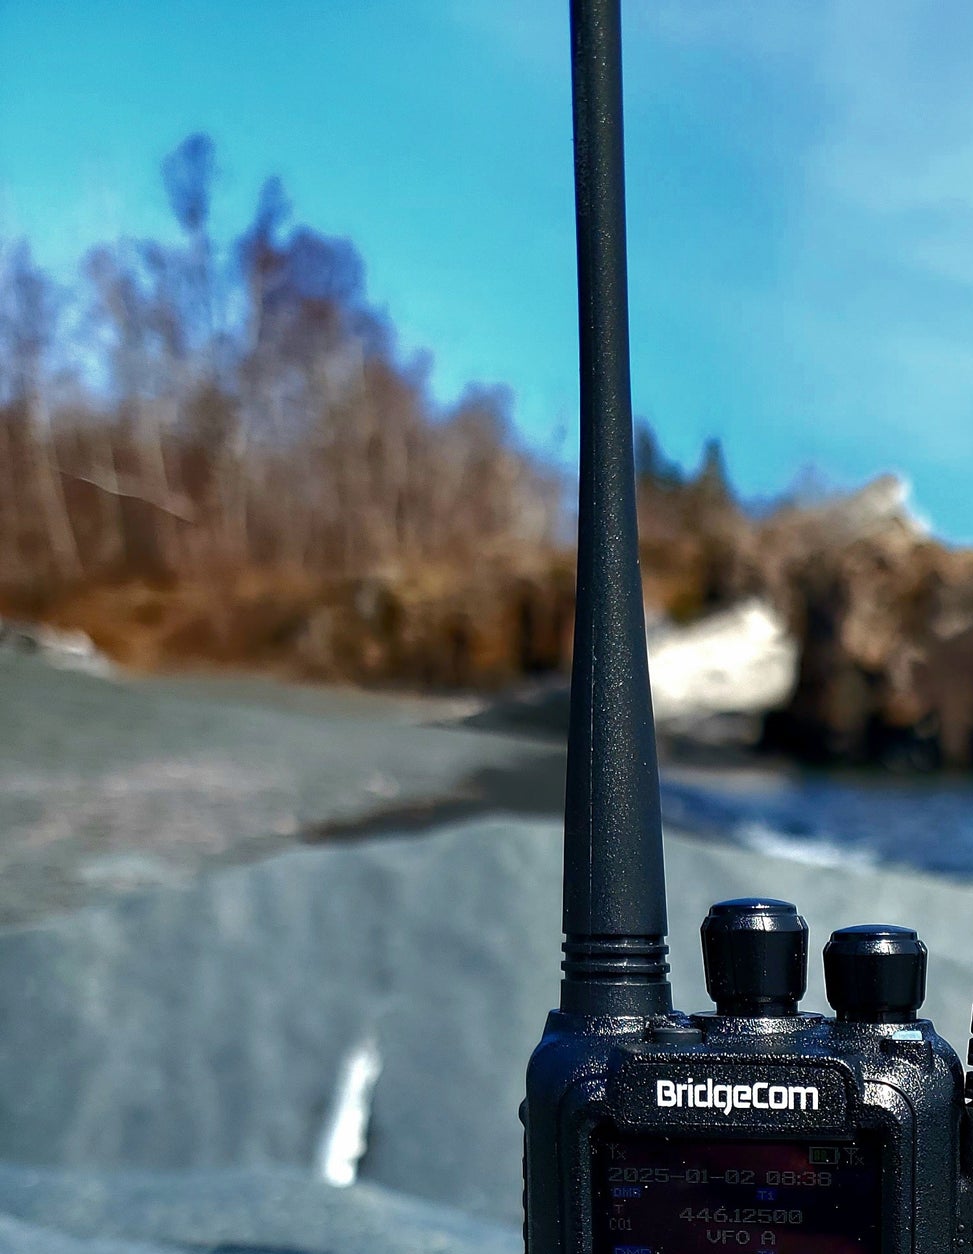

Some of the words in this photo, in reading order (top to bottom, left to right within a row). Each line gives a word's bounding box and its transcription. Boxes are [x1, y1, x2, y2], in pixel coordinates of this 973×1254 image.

[656, 1078, 819, 1115] BridgeCom
[607, 1167, 756, 1185] 2025-01-02
[765, 1170, 832, 1187] 08:38
[679, 1207, 803, 1224] 446.12500
[706, 1229, 751, 1246] VFO
[760, 1230, 776, 1246] A
